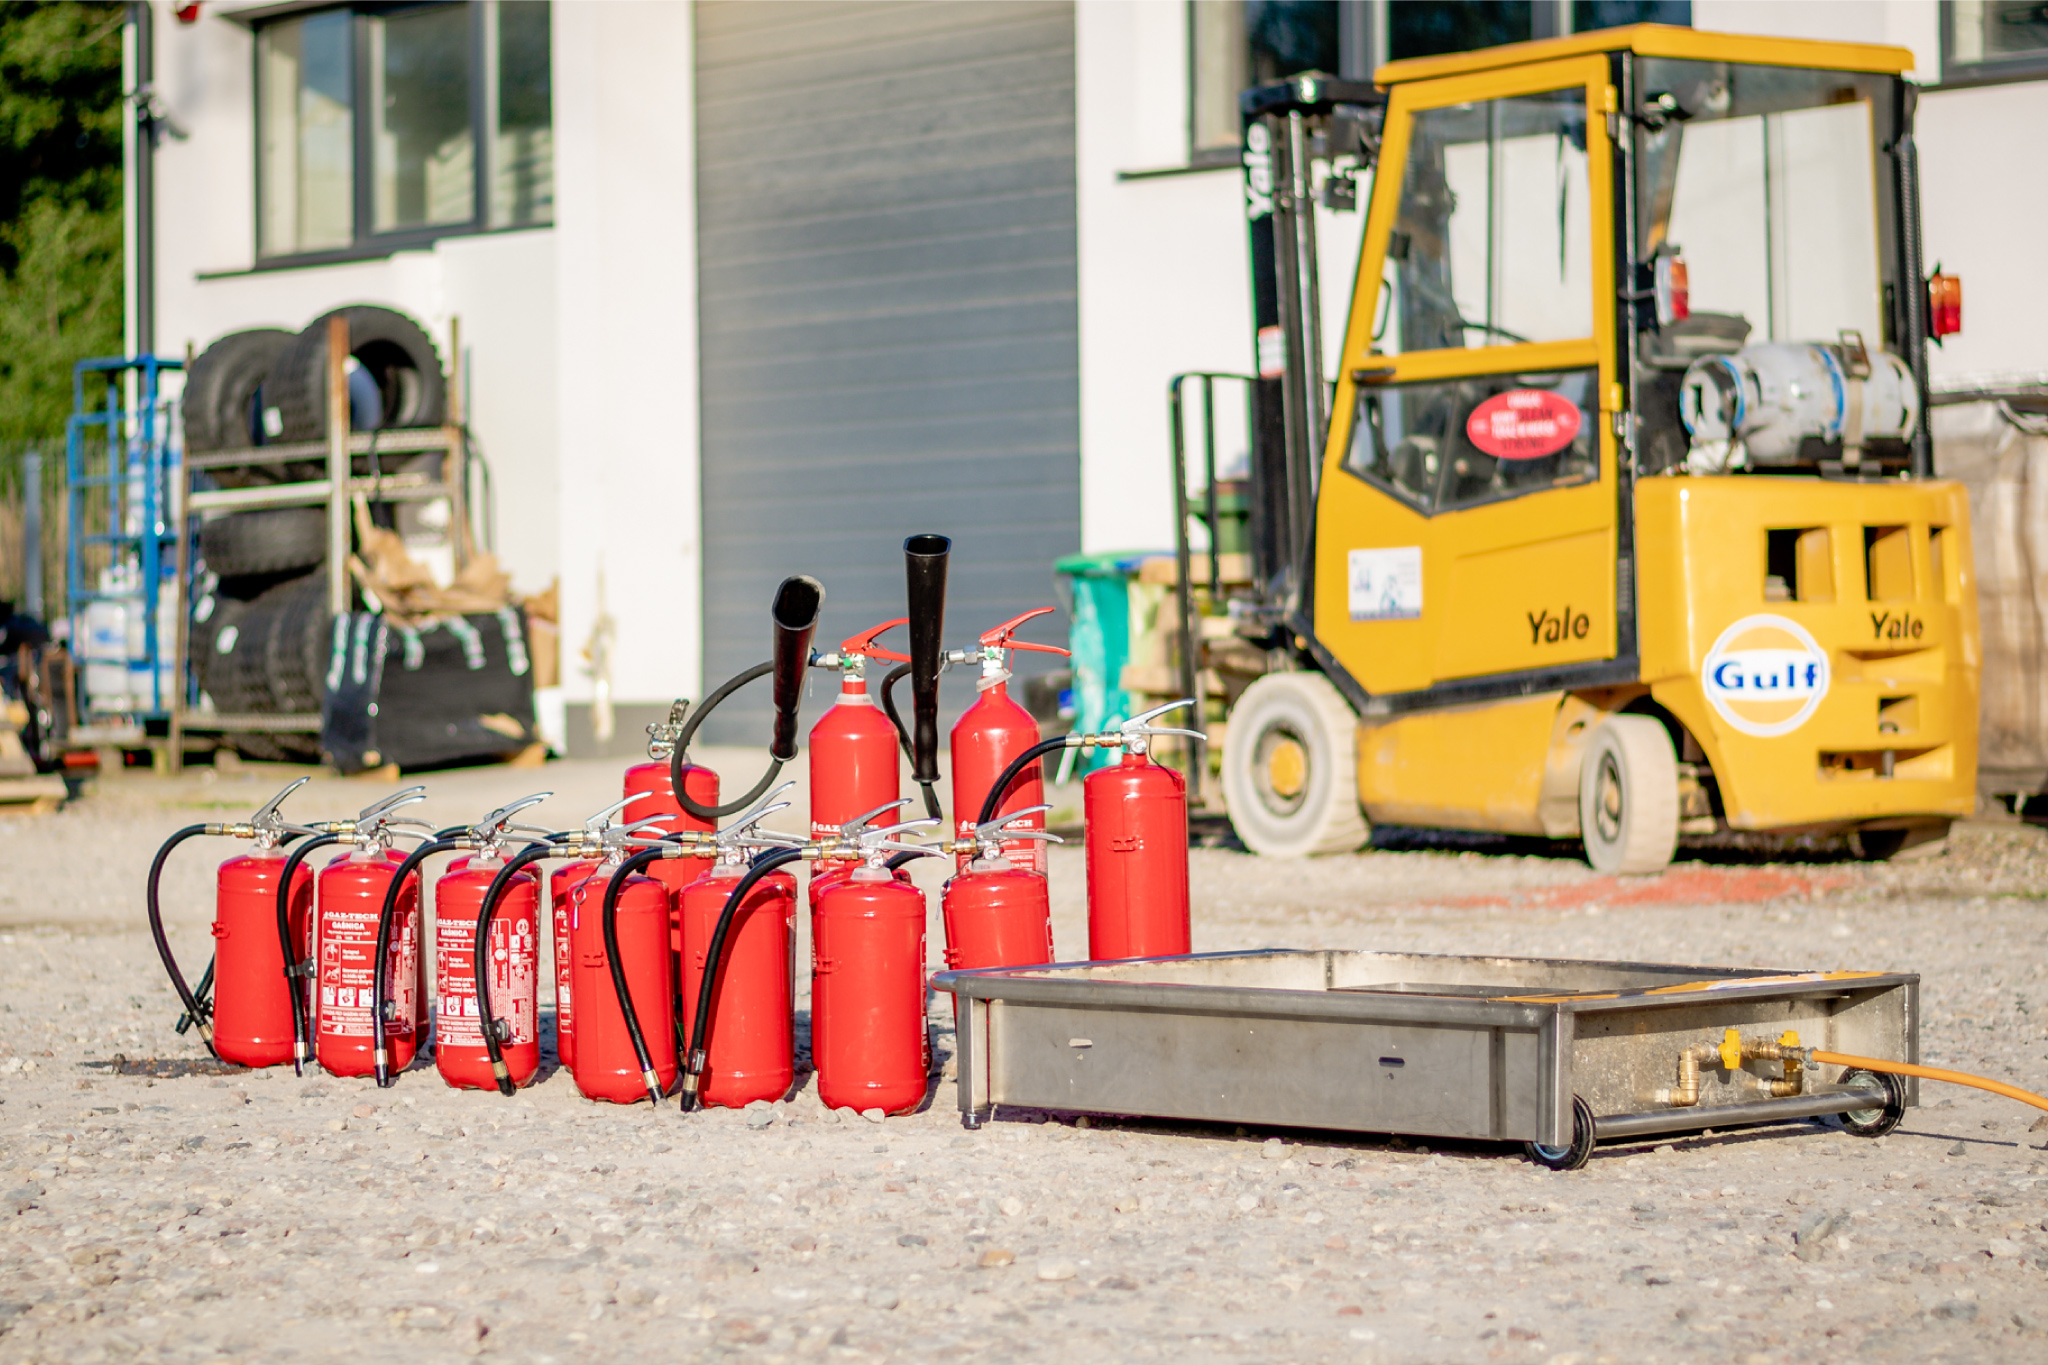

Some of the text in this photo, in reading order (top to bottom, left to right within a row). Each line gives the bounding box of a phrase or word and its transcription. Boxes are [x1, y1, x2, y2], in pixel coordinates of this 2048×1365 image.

[1526, 606, 1590, 645] Yale
[1870, 611, 1924, 639] Yale
[1714, 661, 1818, 690] Gulf
